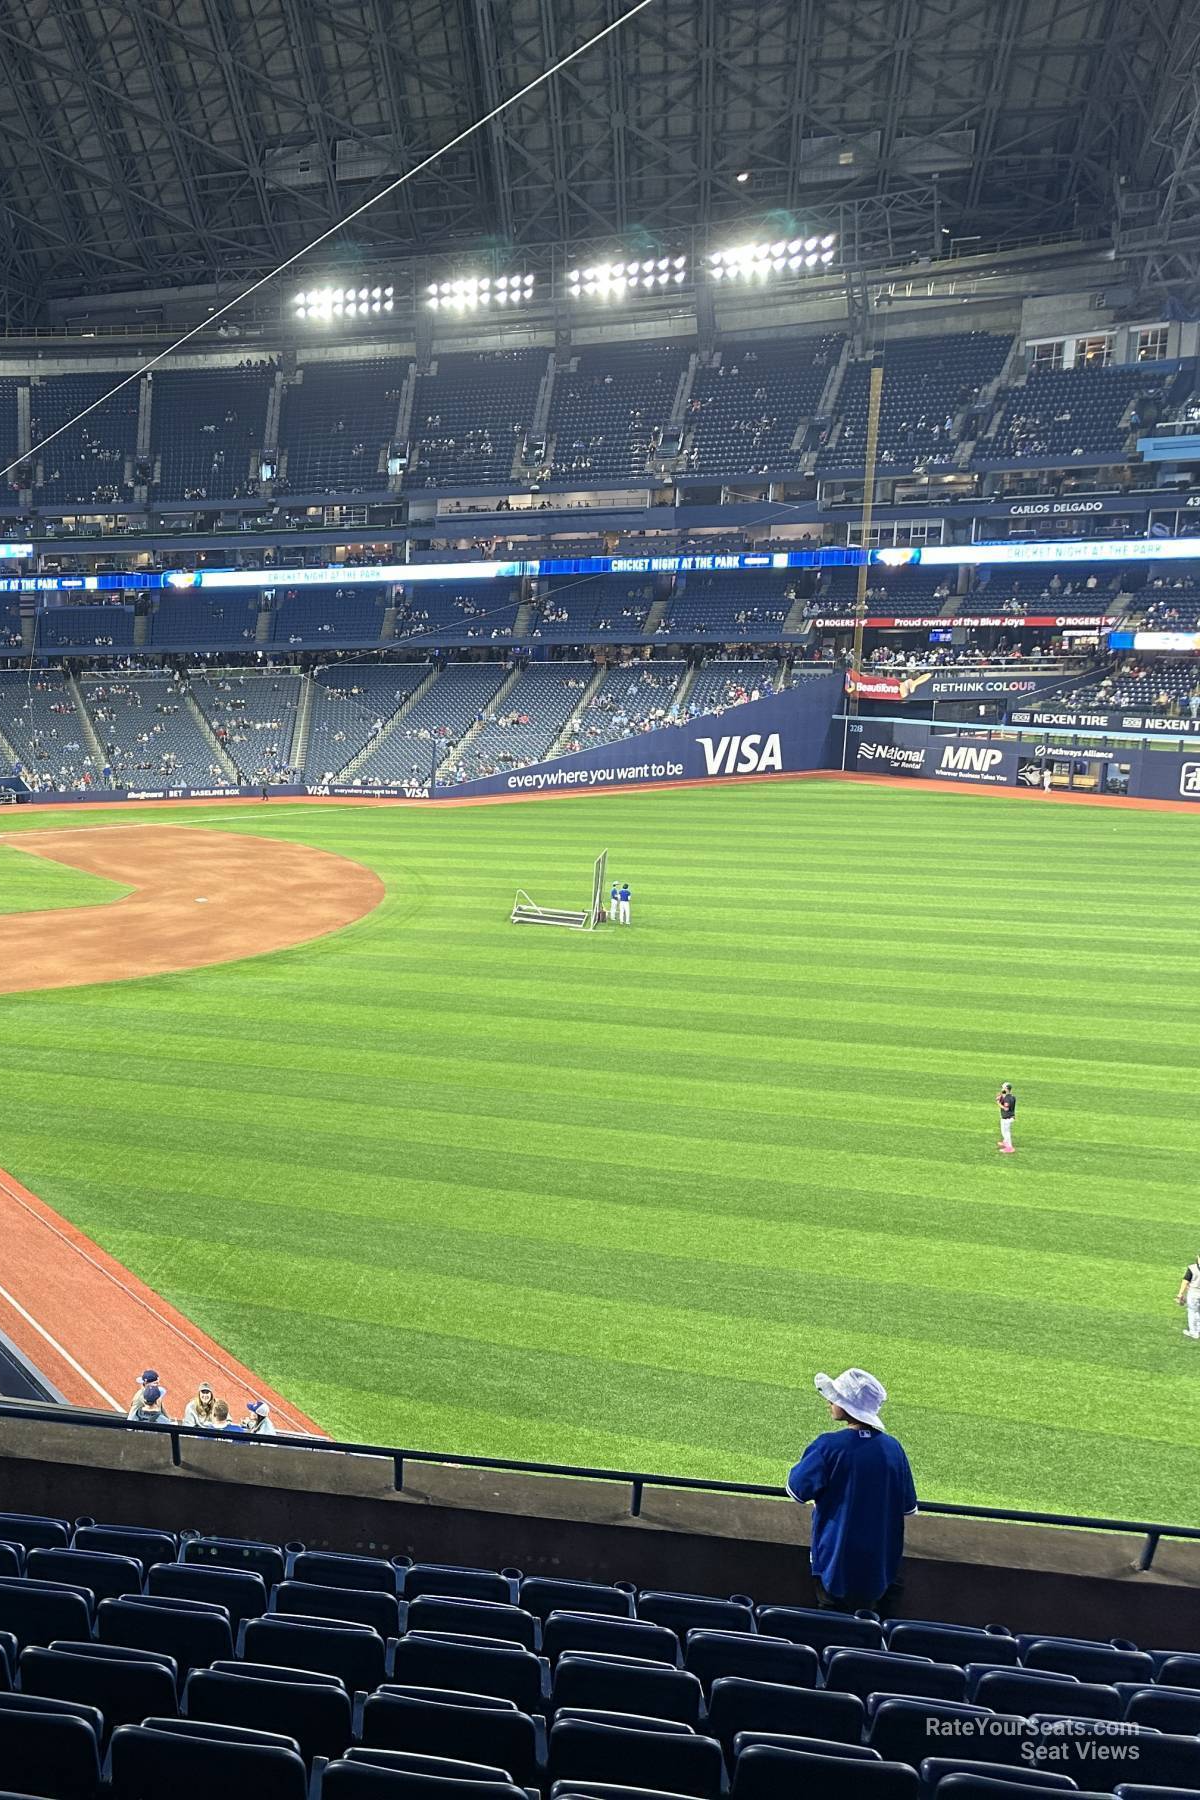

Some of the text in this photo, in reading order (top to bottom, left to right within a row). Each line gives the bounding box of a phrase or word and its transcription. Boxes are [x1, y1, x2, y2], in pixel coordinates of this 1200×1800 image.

[1010, 502, 1103, 514] CARLOS DELGADO
[611, 559, 649, 571] CRICKET
[652, 557, 679, 570] NIGHT
[681, 557, 692, 569] AT
[695, 556, 712, 568] THE
[714, 555, 739, 568] PARK
[10, 580, 20, 590] AT
[22, 579, 35, 589] THE
[37, 578, 58, 589] PARK
[824, 619, 854, 627] ROGERS
[894, 617, 1025, 628] Proud owner of the Blue Jays
[1066, 617, 1100, 626] ROGERS
[933, 682, 1035, 692] RETHINK COLOUR
[1033, 714, 1108, 726] NEXEN TIRE
[1145, 719, 1189, 731] NEXEN
[696, 733, 782, 774] VISA
[941, 746, 1003, 771] MNP
[1047, 747, 1114, 759] Pathways Alliance
[508, 761, 683, 788] everywhere you want to be
[306, 785, 330, 795] VISA
[403, 788, 429, 798] VISA
